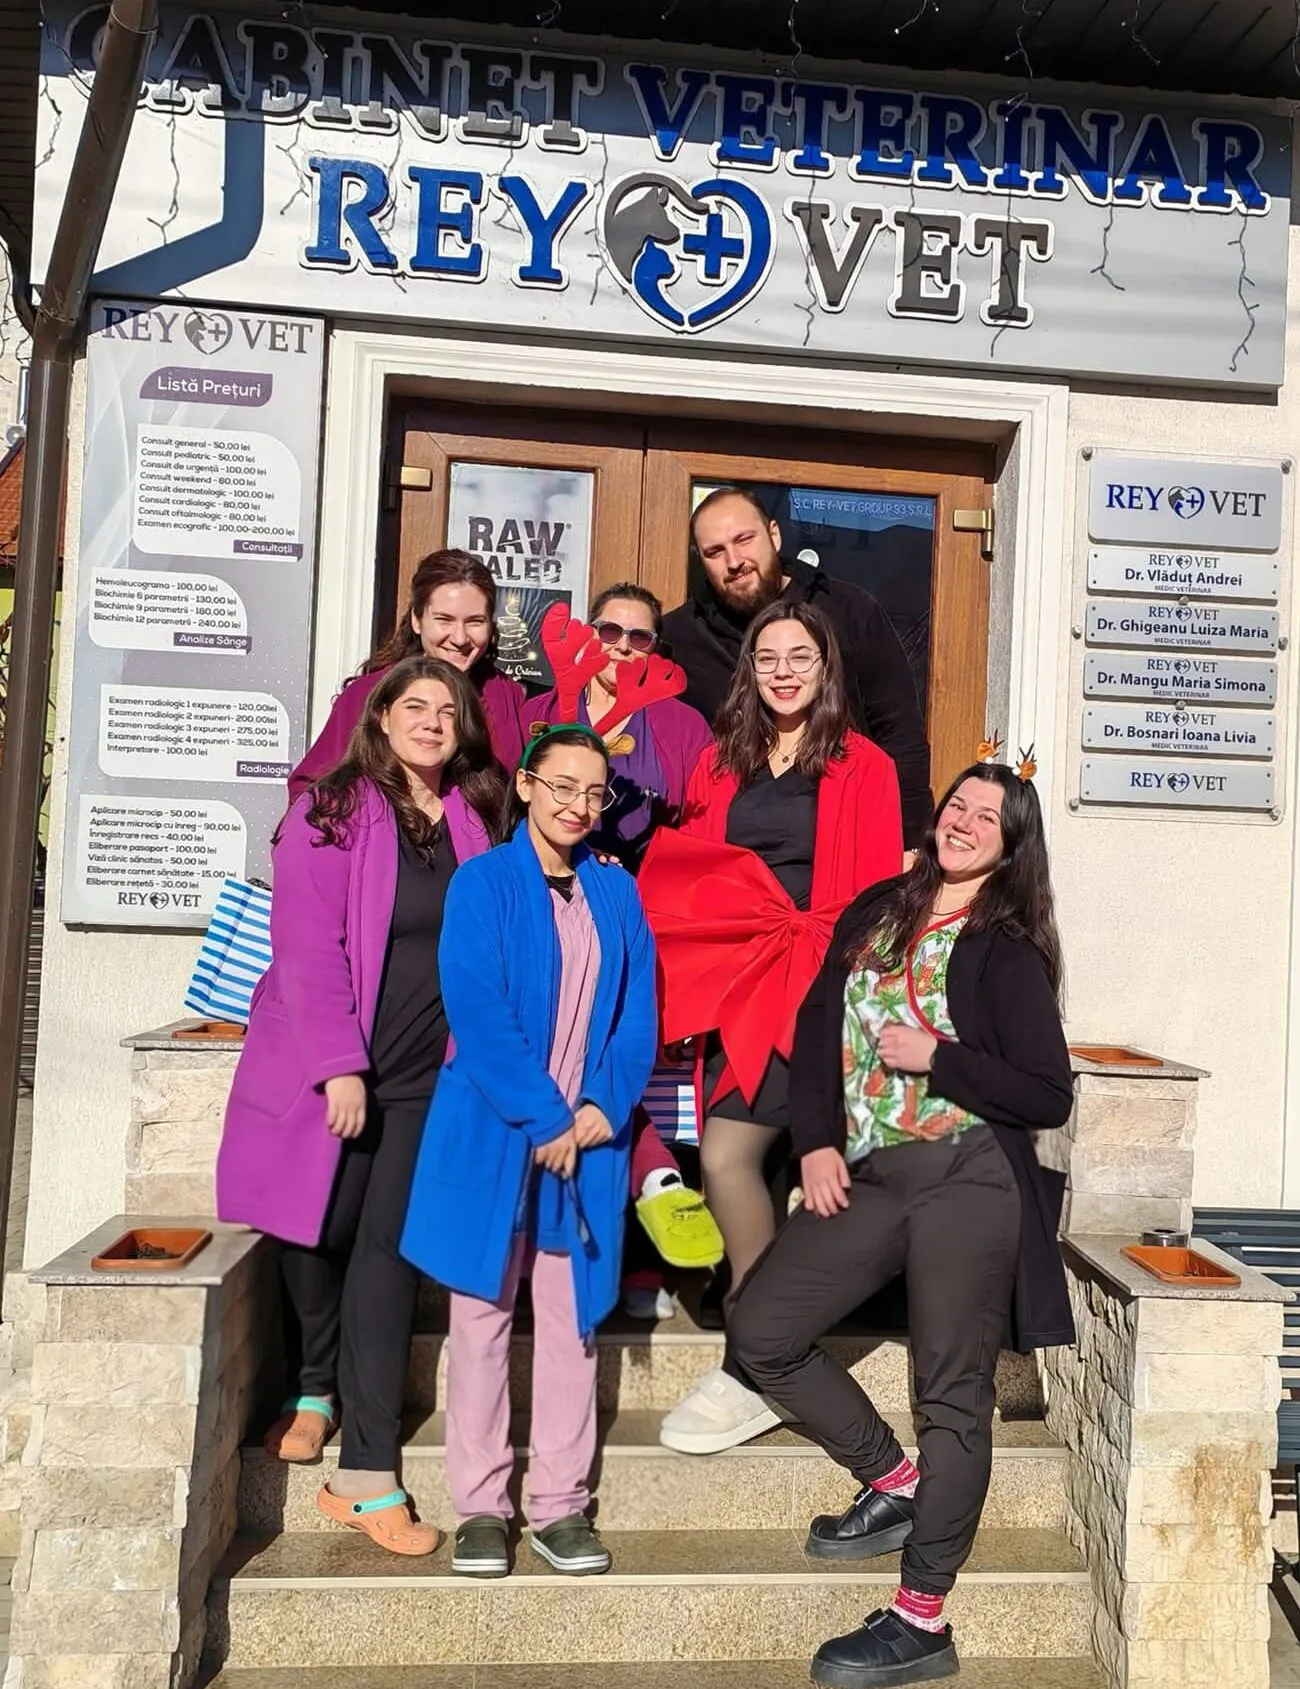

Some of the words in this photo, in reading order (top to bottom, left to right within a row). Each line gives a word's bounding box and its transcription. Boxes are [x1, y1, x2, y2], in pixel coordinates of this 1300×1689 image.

[628, 64, 1269, 211] VETERINAR
[304, 155, 589, 287] REY
[790, 201, 1052, 323] VET
[102, 306, 180, 343] REY
[239, 318, 313, 354] VET
[157, 376, 199, 392] Listă
[202, 379, 261, 399] Prețuri
[141, 436, 173, 445] Consult
[174, 439, 206, 448] general
[240, 442, 250, 451] lei
[140, 447, 172, 457] Consult
[173, 451, 210, 462] pediatric
[244, 455, 255, 463] lei
[140, 459, 172, 469] Consult
[172, 461, 184, 470] de
[256, 467, 266, 476] lei
[139, 471, 172, 481] Consult
[172, 474, 212, 484] weekend
[246, 478, 256, 486] lei
[139, 482, 171, 492] Consult
[171, 485, 226, 500] dermatologic
[264, 491, 275, 499] lei
[138, 494, 170, 504] Consult
[171, 498, 216, 509] cardiologic
[250, 502, 260, 511] lei
[1105, 483, 1164, 511] REY
[1209, 490, 1267, 517] VET
[137, 506, 170, 516] Consult
[170, 509, 222, 522] oftalmologic
[256, 514, 266, 522] lei
[137, 518, 172, 528] Examen
[172, 522, 211, 532] ecografic
[285, 528, 295, 536] lei
[468, 516, 565, 557] RAW
[241, 541, 293, 554] Consultații
[474, 553, 563, 583] ALEO
[1149, 554, 1175, 566] REY
[1195, 557, 1220, 568] VET
[1125, 568, 1144, 580] Dr.
[1148, 569, 1193, 587] Vlăduț
[1196, 573, 1242, 586] Andrei
[208, 584, 218, 592] lei
[94, 588, 135, 599] Biochimie
[136, 591, 143, 599] 6
[226, 596, 237, 605] lei
[93, 600, 134, 611] Biochimie
[135, 603, 142, 611] 9
[226, 608, 236, 617] lei
[1148, 606, 1174, 618] REY
[1195, 609, 1220, 620] VET
[93, 612, 134, 622] Biochimie
[135, 615, 145, 623] 12
[231, 620, 241, 628] lei
[1097, 618, 1116, 630] Dr.
[1120, 619, 1187, 635] Ghigeanu
[1191, 623, 1226, 636] Luiza
[1230, 626, 1269, 639] Maria
[179, 634, 214, 645] Analize
[1147, 658, 1173, 670] REY
[1193, 661, 1218, 673] VET
[1097, 672, 1117, 684] Dr.
[1121, 673, 1168, 689] Mangu
[1172, 676, 1211, 689] Maria
[1215, 678, 1266, 692] Simona
[108, 695, 144, 706] Examen
[144, 698, 185, 711] radiologic
[186, 700, 190, 708] 1
[191, 702, 231, 710] expunere
[108, 707, 143, 717] Examen
[143, 710, 184, 721] radiologic
[185, 711, 192, 720] 2
[1145, 711, 1171, 723] REY
[1191, 714, 1216, 726] VET
[107, 719, 142, 729] Examen
[143, 722, 184, 734] radiologic
[185, 723, 192, 732] 3
[192, 724, 230, 734] expuneri
[267, 727, 278, 736] lei
[1104, 725, 1123, 737] Dr.
[1127, 726, 1179, 740] Bosnari
[1183, 729, 1221, 742] Ioana
[1224, 731, 1256, 743] Livia
[106, 731, 142, 742] Examen
[143, 733, 184, 745] radiologic
[184, 735, 191, 743] 4
[192, 737, 230, 745] expuneri
[268, 739, 279, 747] lei
[106, 743, 159, 753] Interpretare
[197, 747, 208, 756] lei
[240, 764, 290, 777] Radiologie
[1130, 772, 1165, 788] REY
[1192, 775, 1227, 791] VET
[90, 805, 126, 818] Aplicare
[127, 807, 163, 819] microcip
[197, 810, 207, 818] lei
[89, 817, 126, 830] Aplicare
[126, 819, 162, 831] microcip
[163, 820, 173, 829] cu
[231, 823, 241, 831] lei
[193, 834, 204, 842] lei
[88, 841, 128, 852] Eliberare
[206, 846, 217, 854] lei
[107, 853, 128, 862] clinic
[197, 857, 208, 865] lei
[86, 865, 126, 875] Eliberare
[127, 868, 155, 877] carnet
[85, 877, 125, 886] Eliberare
[188, 881, 199, 889] lei
[118, 892, 149, 905] REY
[172, 894, 202, 907] VET
